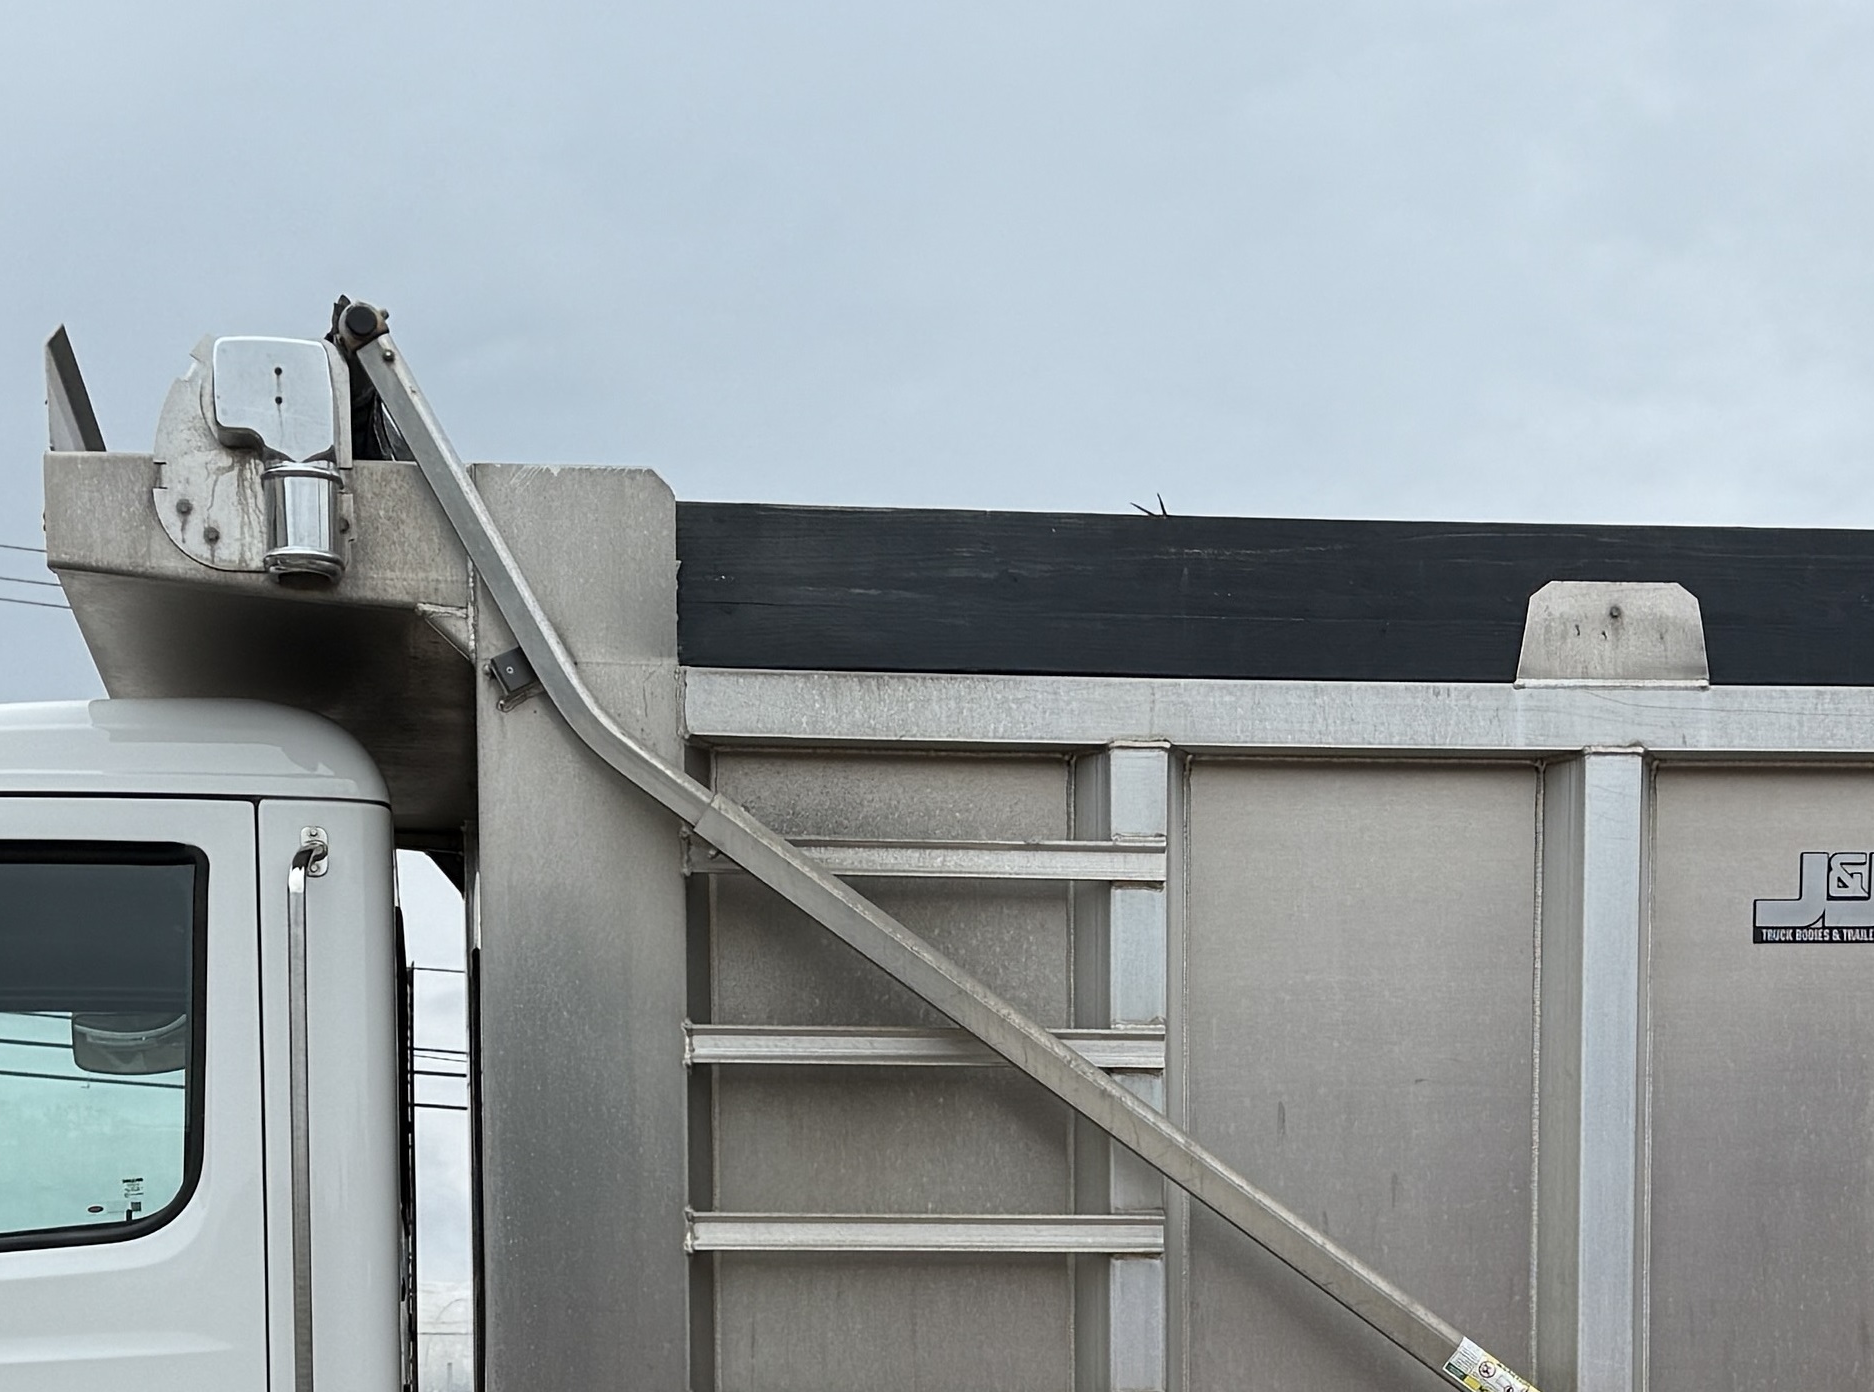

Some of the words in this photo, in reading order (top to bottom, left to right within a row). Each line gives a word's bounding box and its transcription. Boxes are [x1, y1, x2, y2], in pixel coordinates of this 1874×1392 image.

[1762, 929, 1793, 941] TRUCK
[1796, 929, 1829, 941] BODIES
[1832, 929, 1841, 941] &
